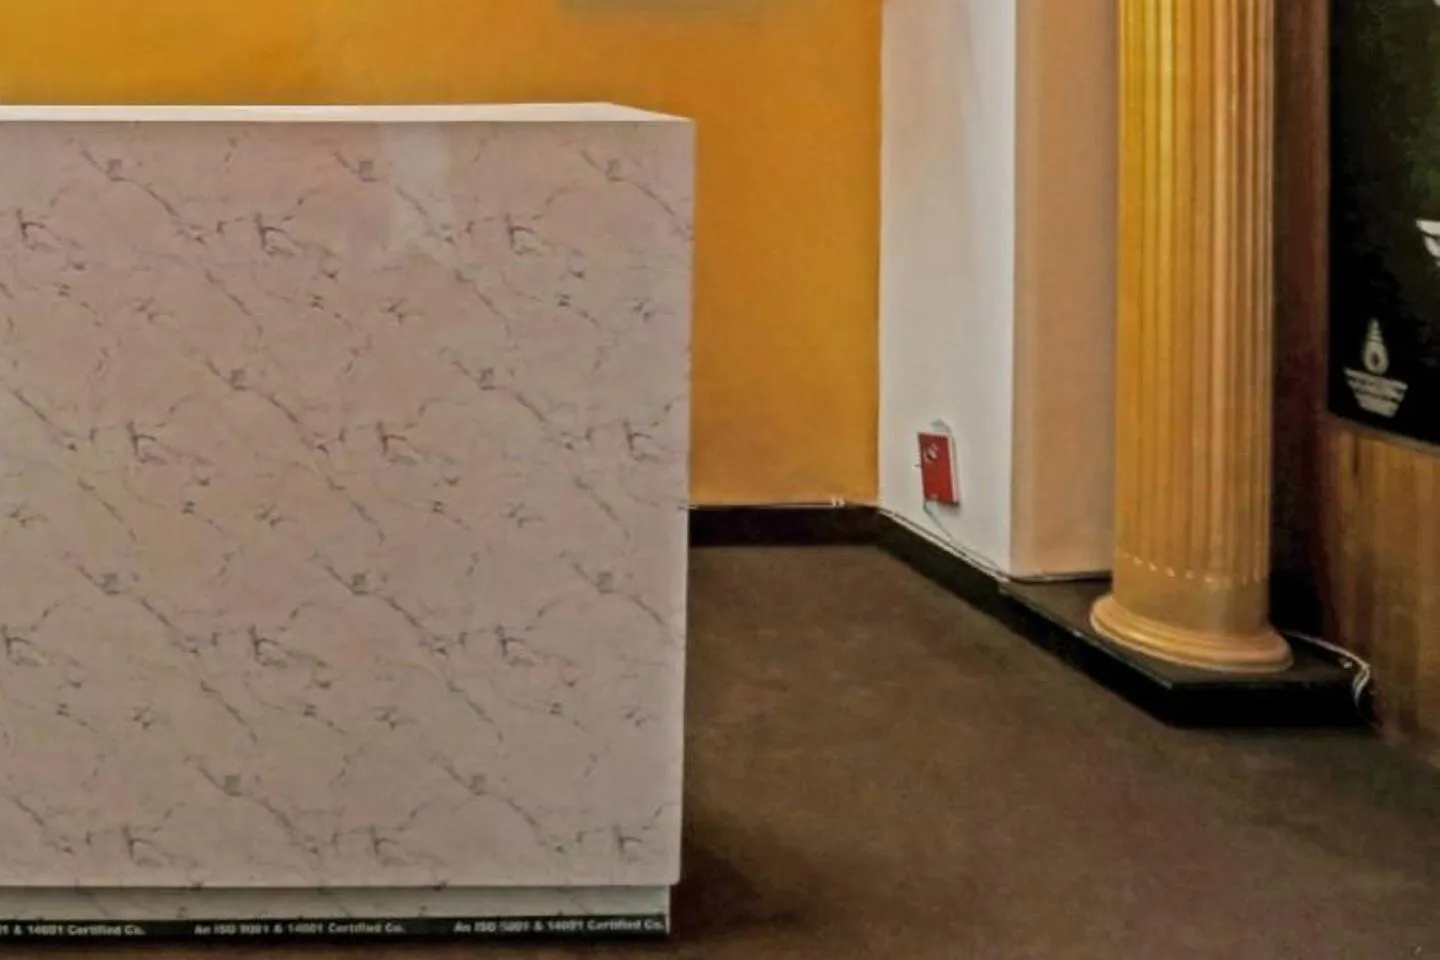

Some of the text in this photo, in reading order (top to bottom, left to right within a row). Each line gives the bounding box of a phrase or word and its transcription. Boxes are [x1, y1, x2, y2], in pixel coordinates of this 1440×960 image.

[66, 924, 122, 936] Certified
[327, 922, 382, 933] Certified
[586, 919, 641, 931] Certified
